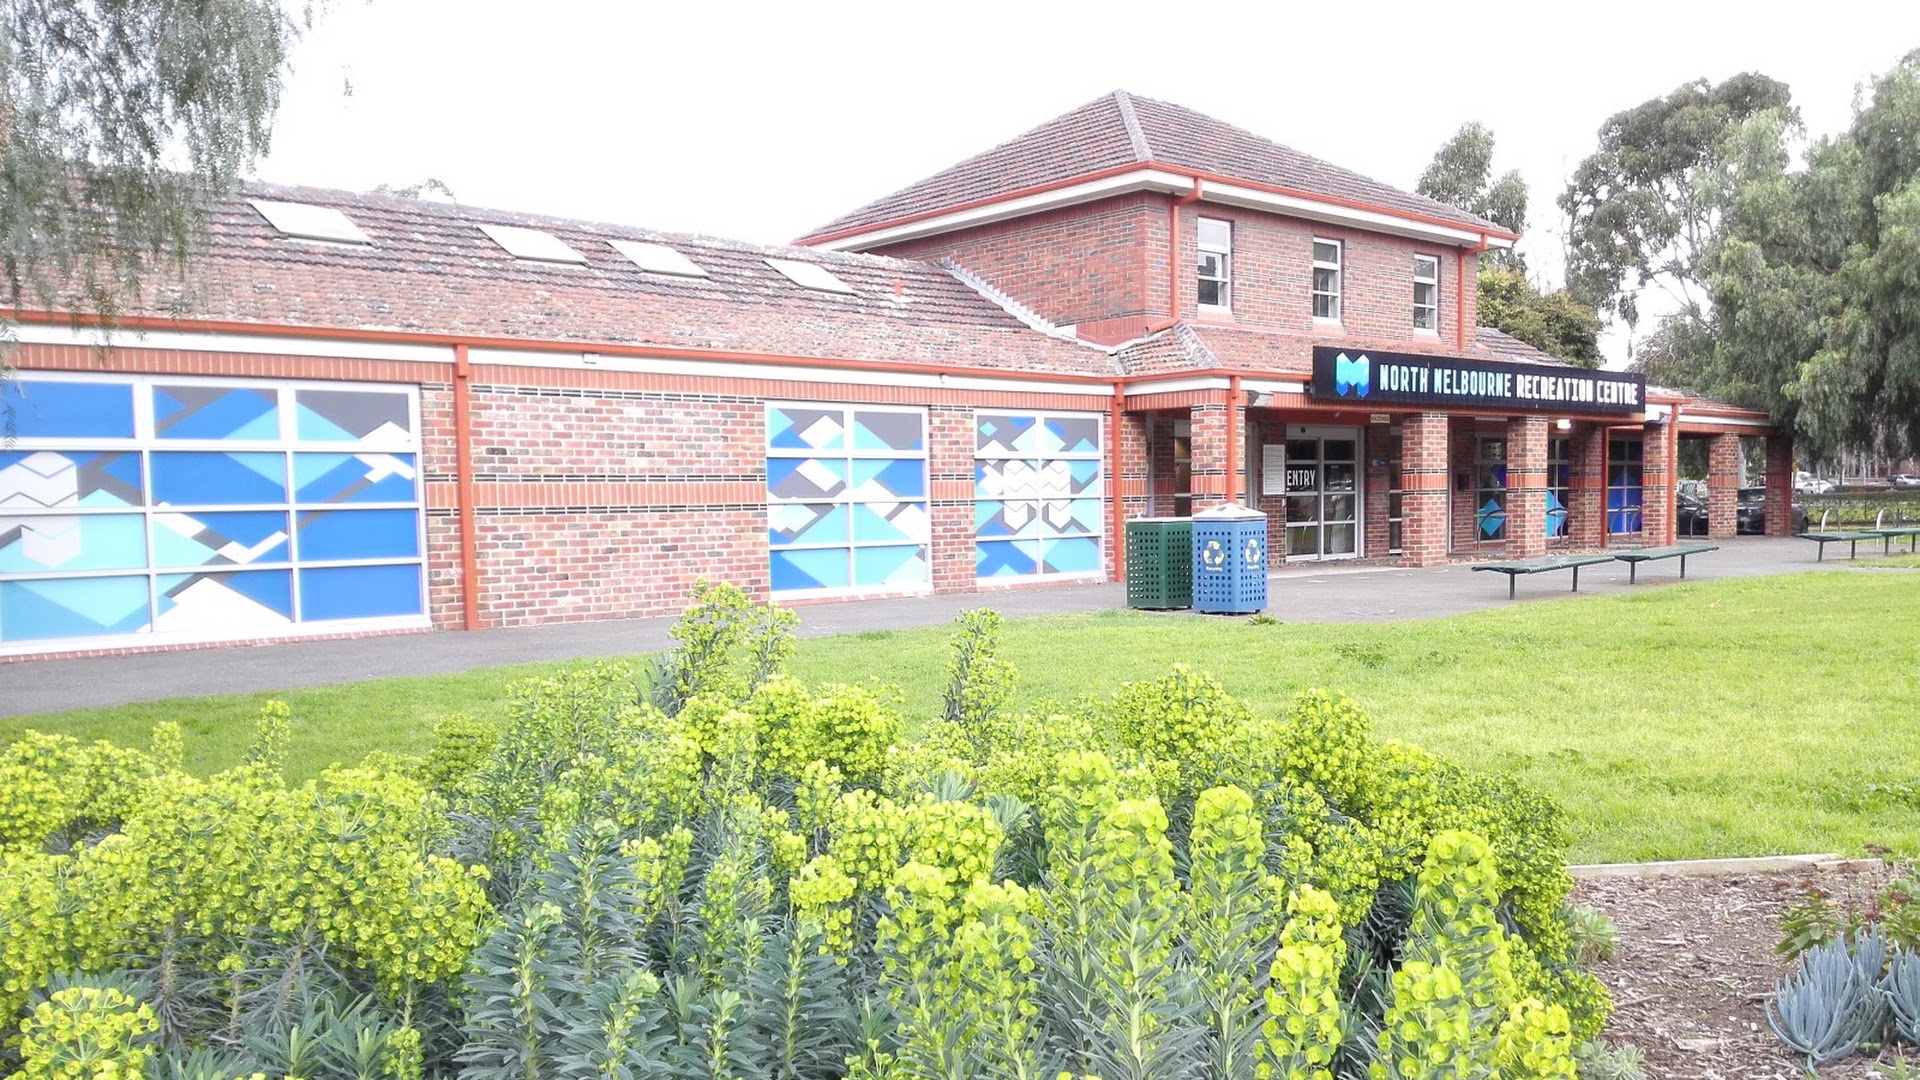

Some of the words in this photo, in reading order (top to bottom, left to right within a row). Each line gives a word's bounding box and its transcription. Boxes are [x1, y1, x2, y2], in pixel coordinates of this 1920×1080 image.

[1380, 364, 1428, 393] NORTH
[1434, 368, 1512, 397] MELBOURNE
[1516, 374, 1594, 402] RECREATION
[1597, 380, 1638, 405] CENTRE
[1287, 470, 1315, 486] ENTRY
